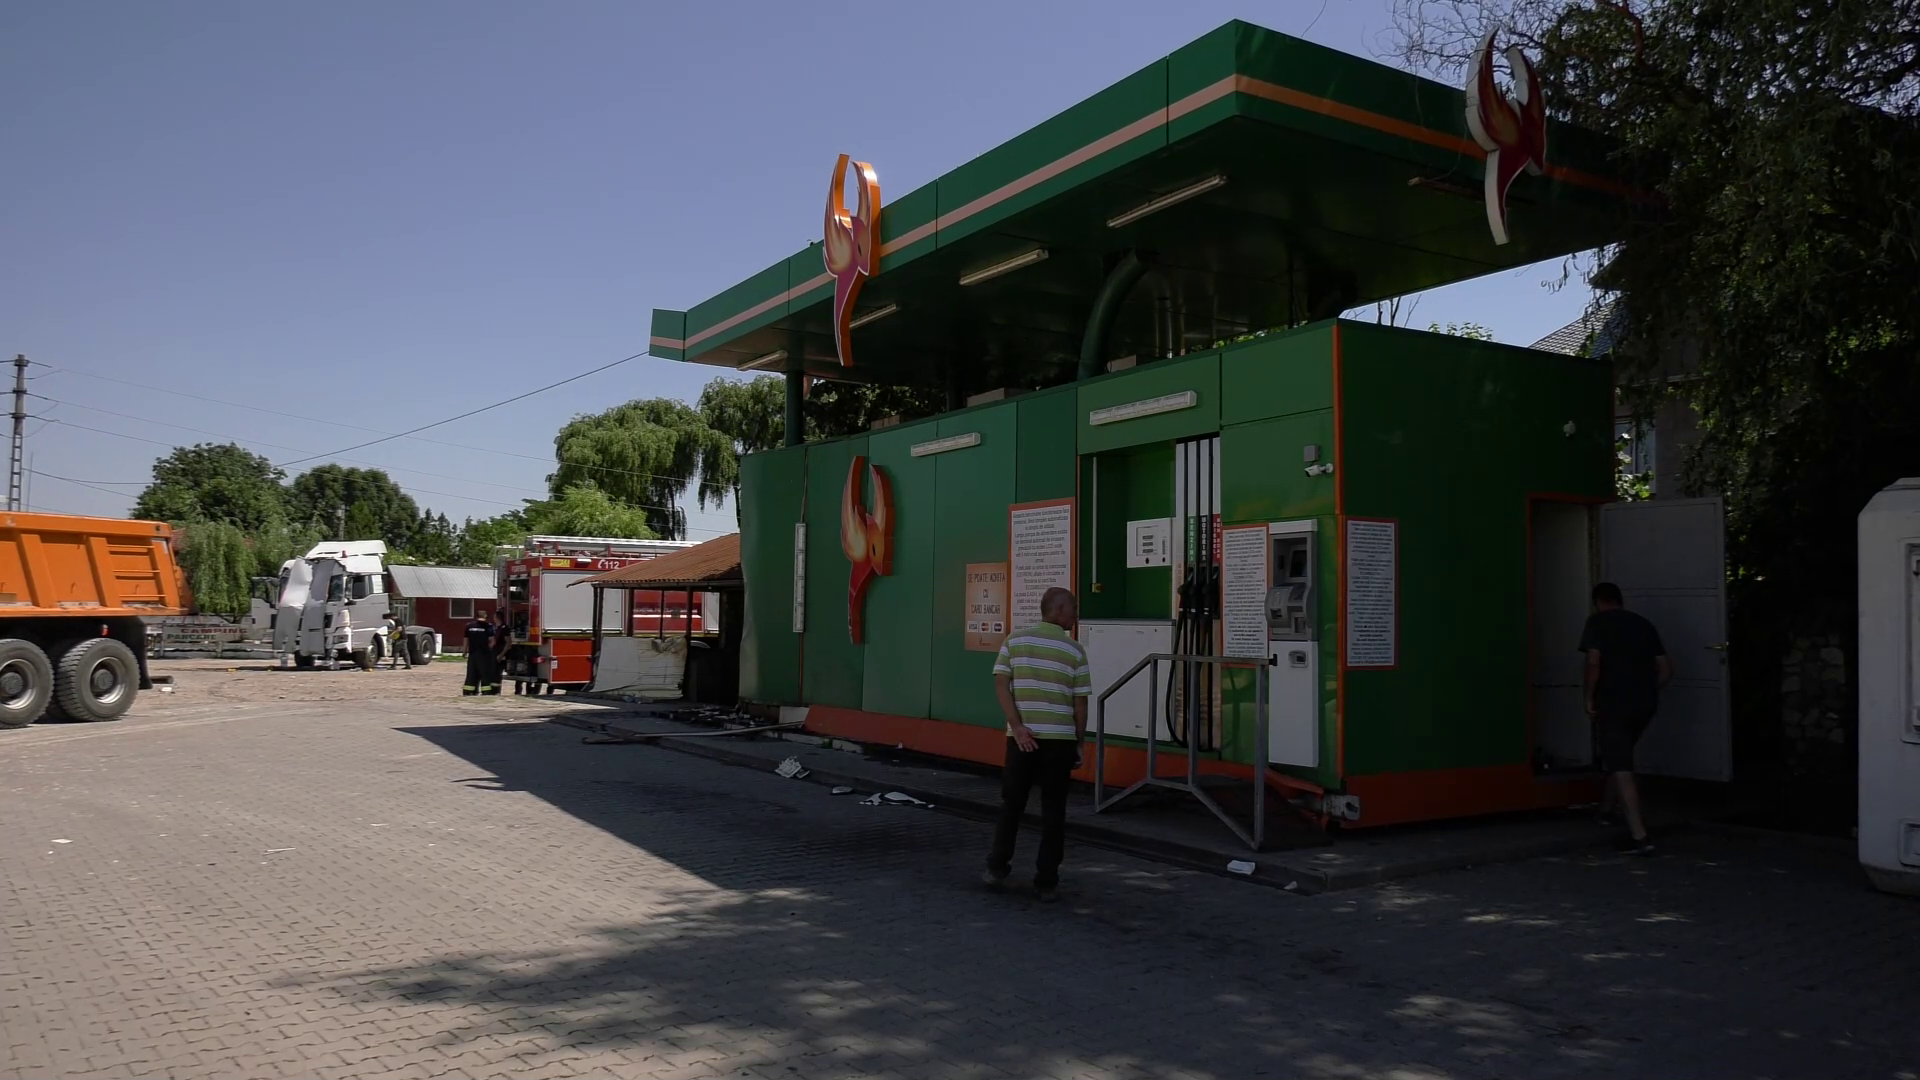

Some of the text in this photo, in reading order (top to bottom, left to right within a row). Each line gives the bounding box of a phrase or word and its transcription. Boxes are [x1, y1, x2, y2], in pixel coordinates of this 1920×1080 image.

[603, 560, 620, 570] 112
[974, 573, 988, 583] POATE
[983, 588, 989, 599] CU
[971, 604, 1001, 614] CARD BANCAR
